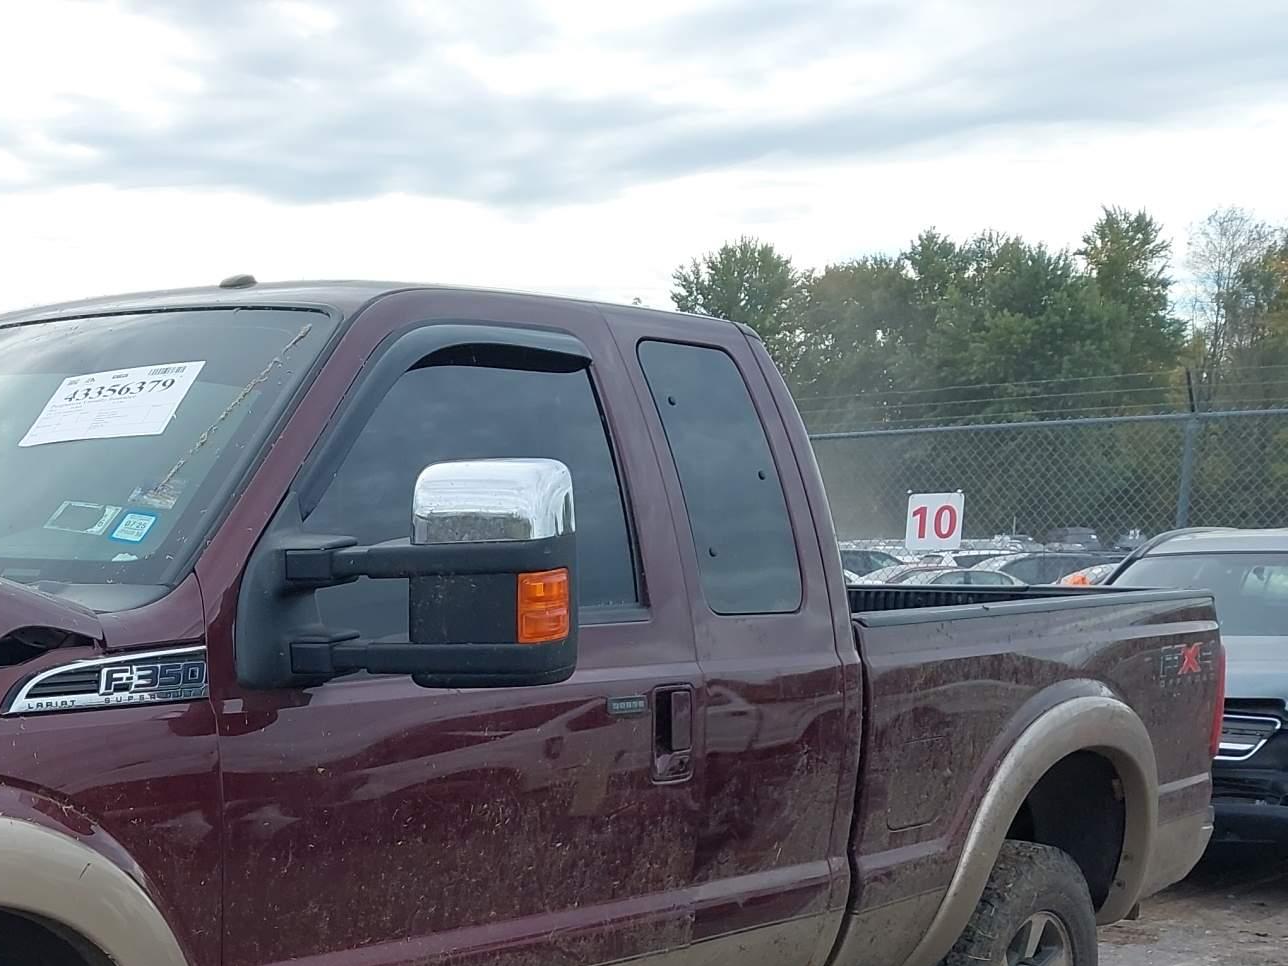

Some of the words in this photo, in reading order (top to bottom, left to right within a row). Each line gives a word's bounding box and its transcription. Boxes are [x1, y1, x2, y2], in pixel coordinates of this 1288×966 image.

[64, 378, 176, 402] 43356379
[912, 505, 957, 539] 10
[27, 700, 77, 710] LARIAT
[103, 693, 157, 704] SUPER
